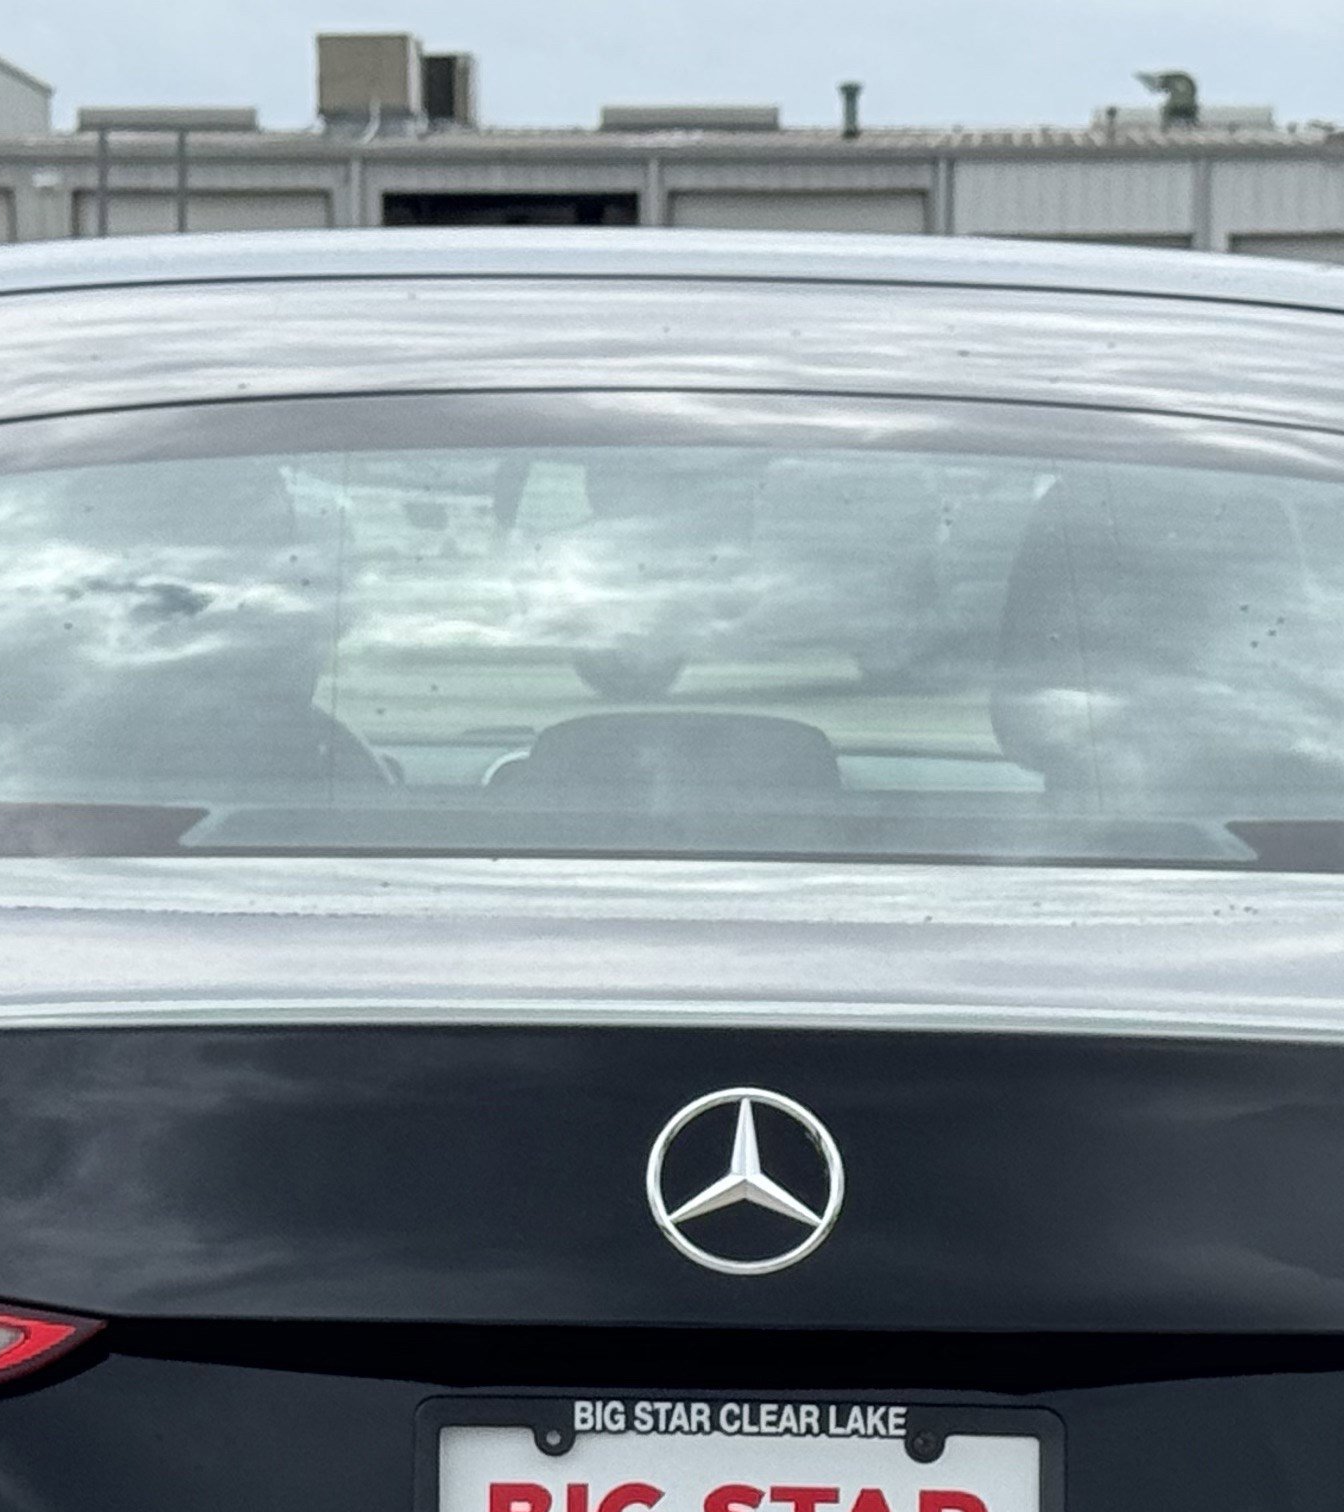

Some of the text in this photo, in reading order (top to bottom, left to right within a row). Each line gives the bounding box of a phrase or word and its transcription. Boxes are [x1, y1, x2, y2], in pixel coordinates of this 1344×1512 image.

[574, 1401, 907, 1436] BIG STAR CLEAR LAKE
